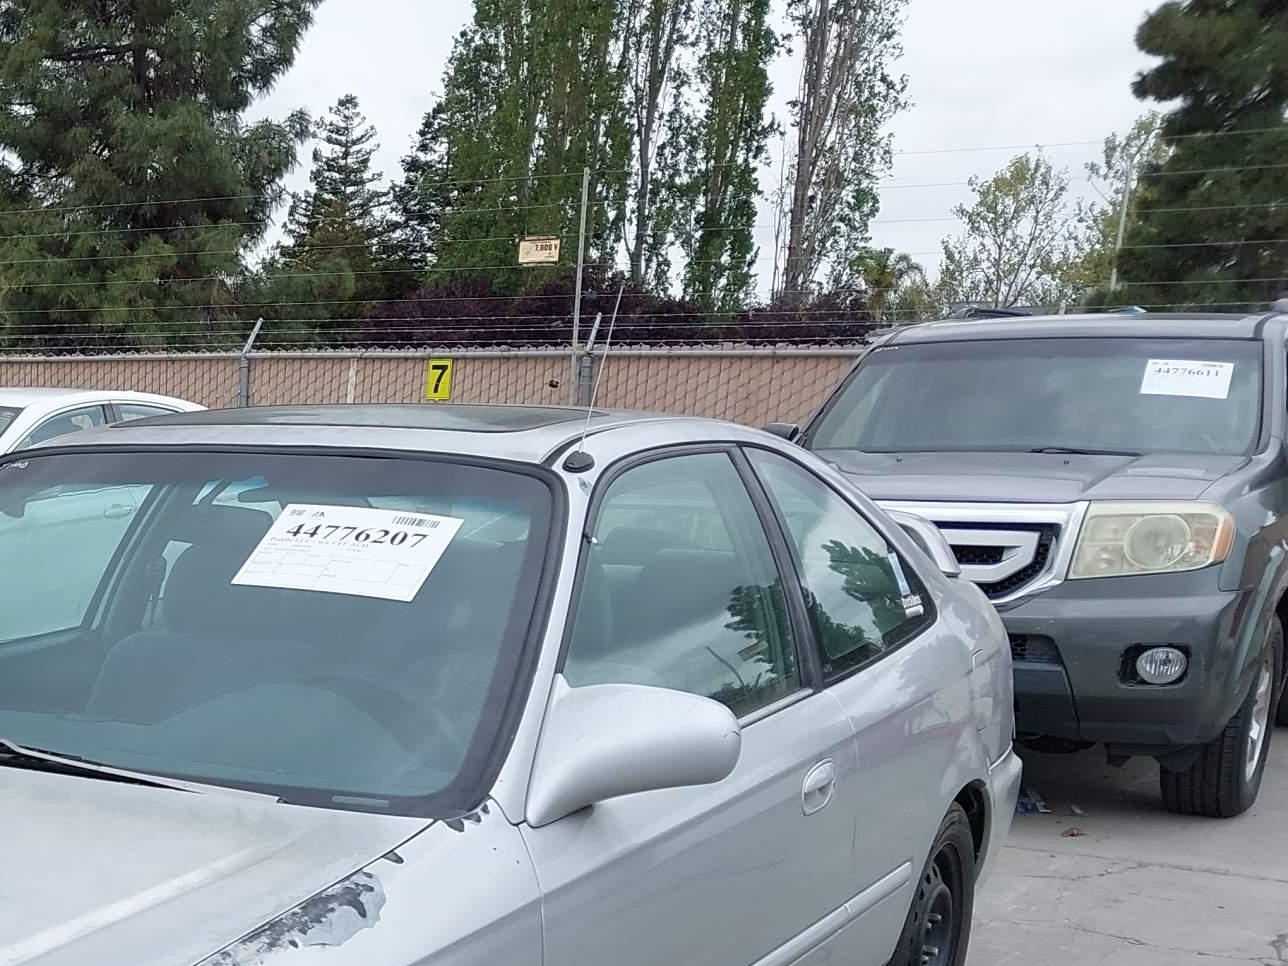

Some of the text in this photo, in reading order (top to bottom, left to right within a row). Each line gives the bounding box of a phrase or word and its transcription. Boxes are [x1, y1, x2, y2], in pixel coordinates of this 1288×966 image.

[431, 364, 449, 394] 7
[1154, 367, 1220, 377] 44776611
[286, 523, 429, 548] 44776207
